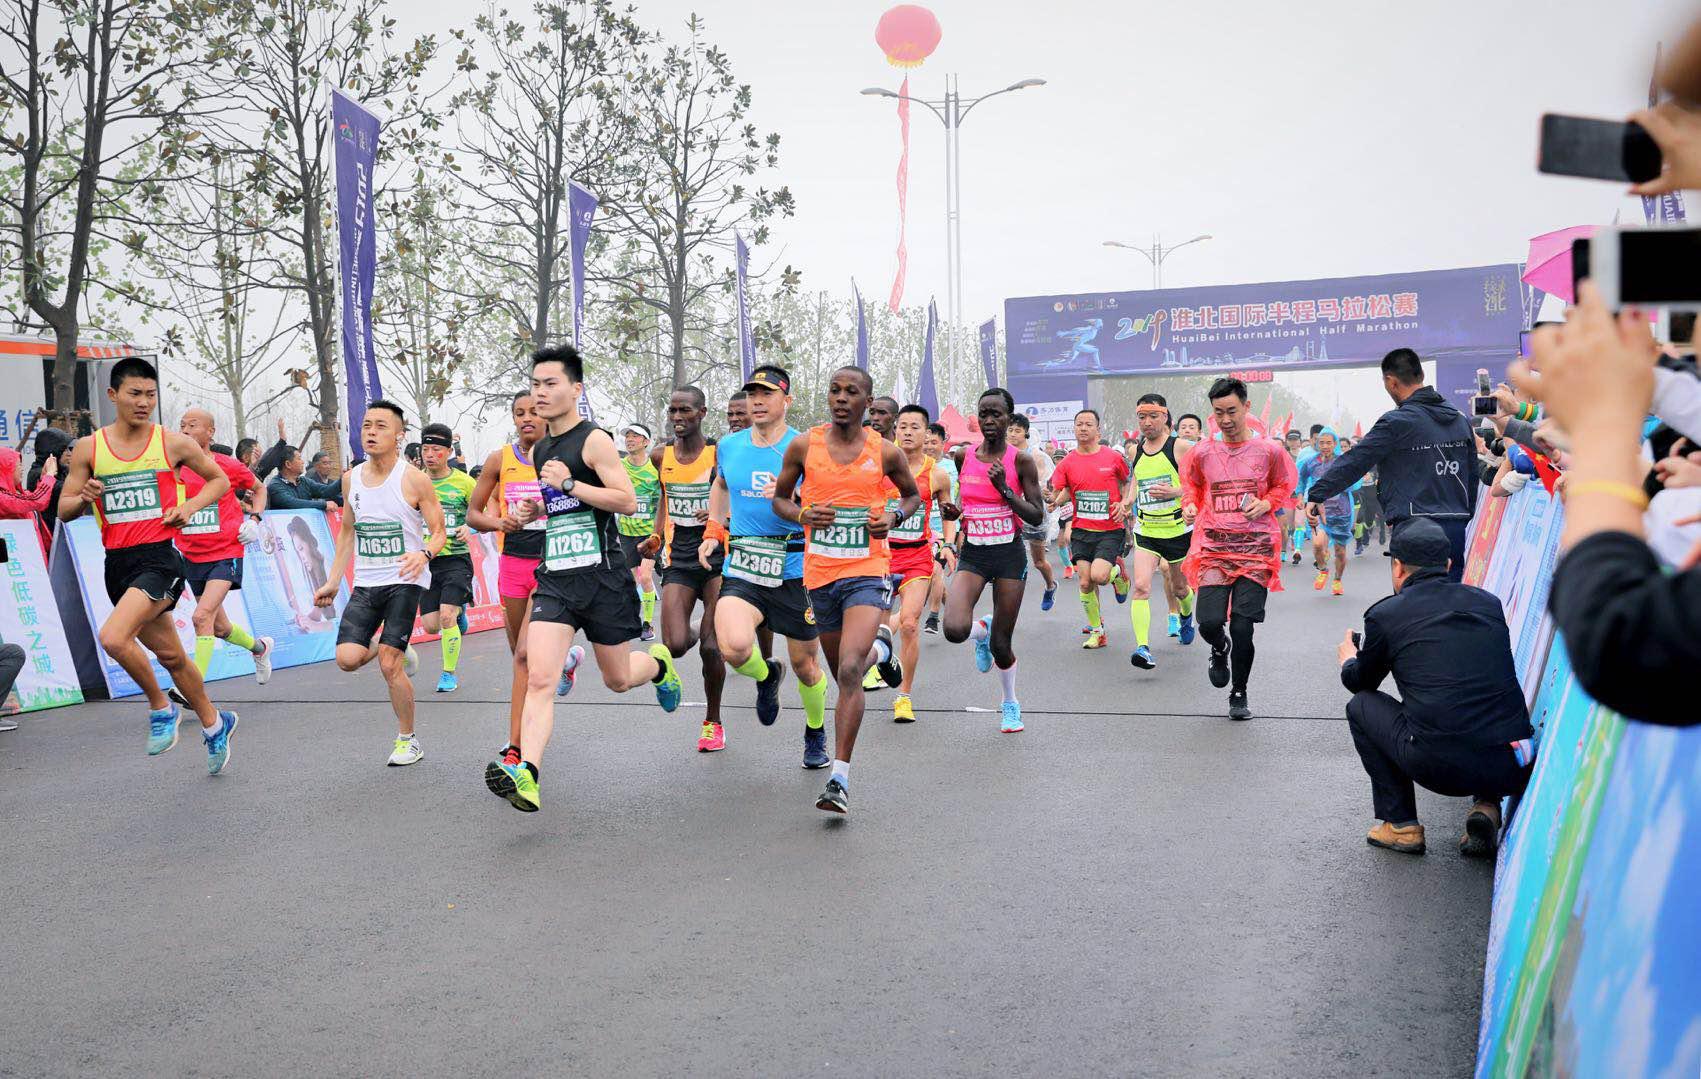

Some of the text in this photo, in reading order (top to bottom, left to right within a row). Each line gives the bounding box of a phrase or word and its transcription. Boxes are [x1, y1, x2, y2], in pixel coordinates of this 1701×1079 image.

[1171, 292, 1418, 331] 淮北国际半程马拉松赛
[1172, 320, 1418, 344] HuaiBei International Half Marathon
[105, 487, 157, 512] A2319
[814, 526, 865, 545] A2311
[968, 517, 1013, 535] A3399
[359, 536, 401, 556] A1630
[547, 531, 595, 558] A1262
[730, 549, 783, 577] A2366
